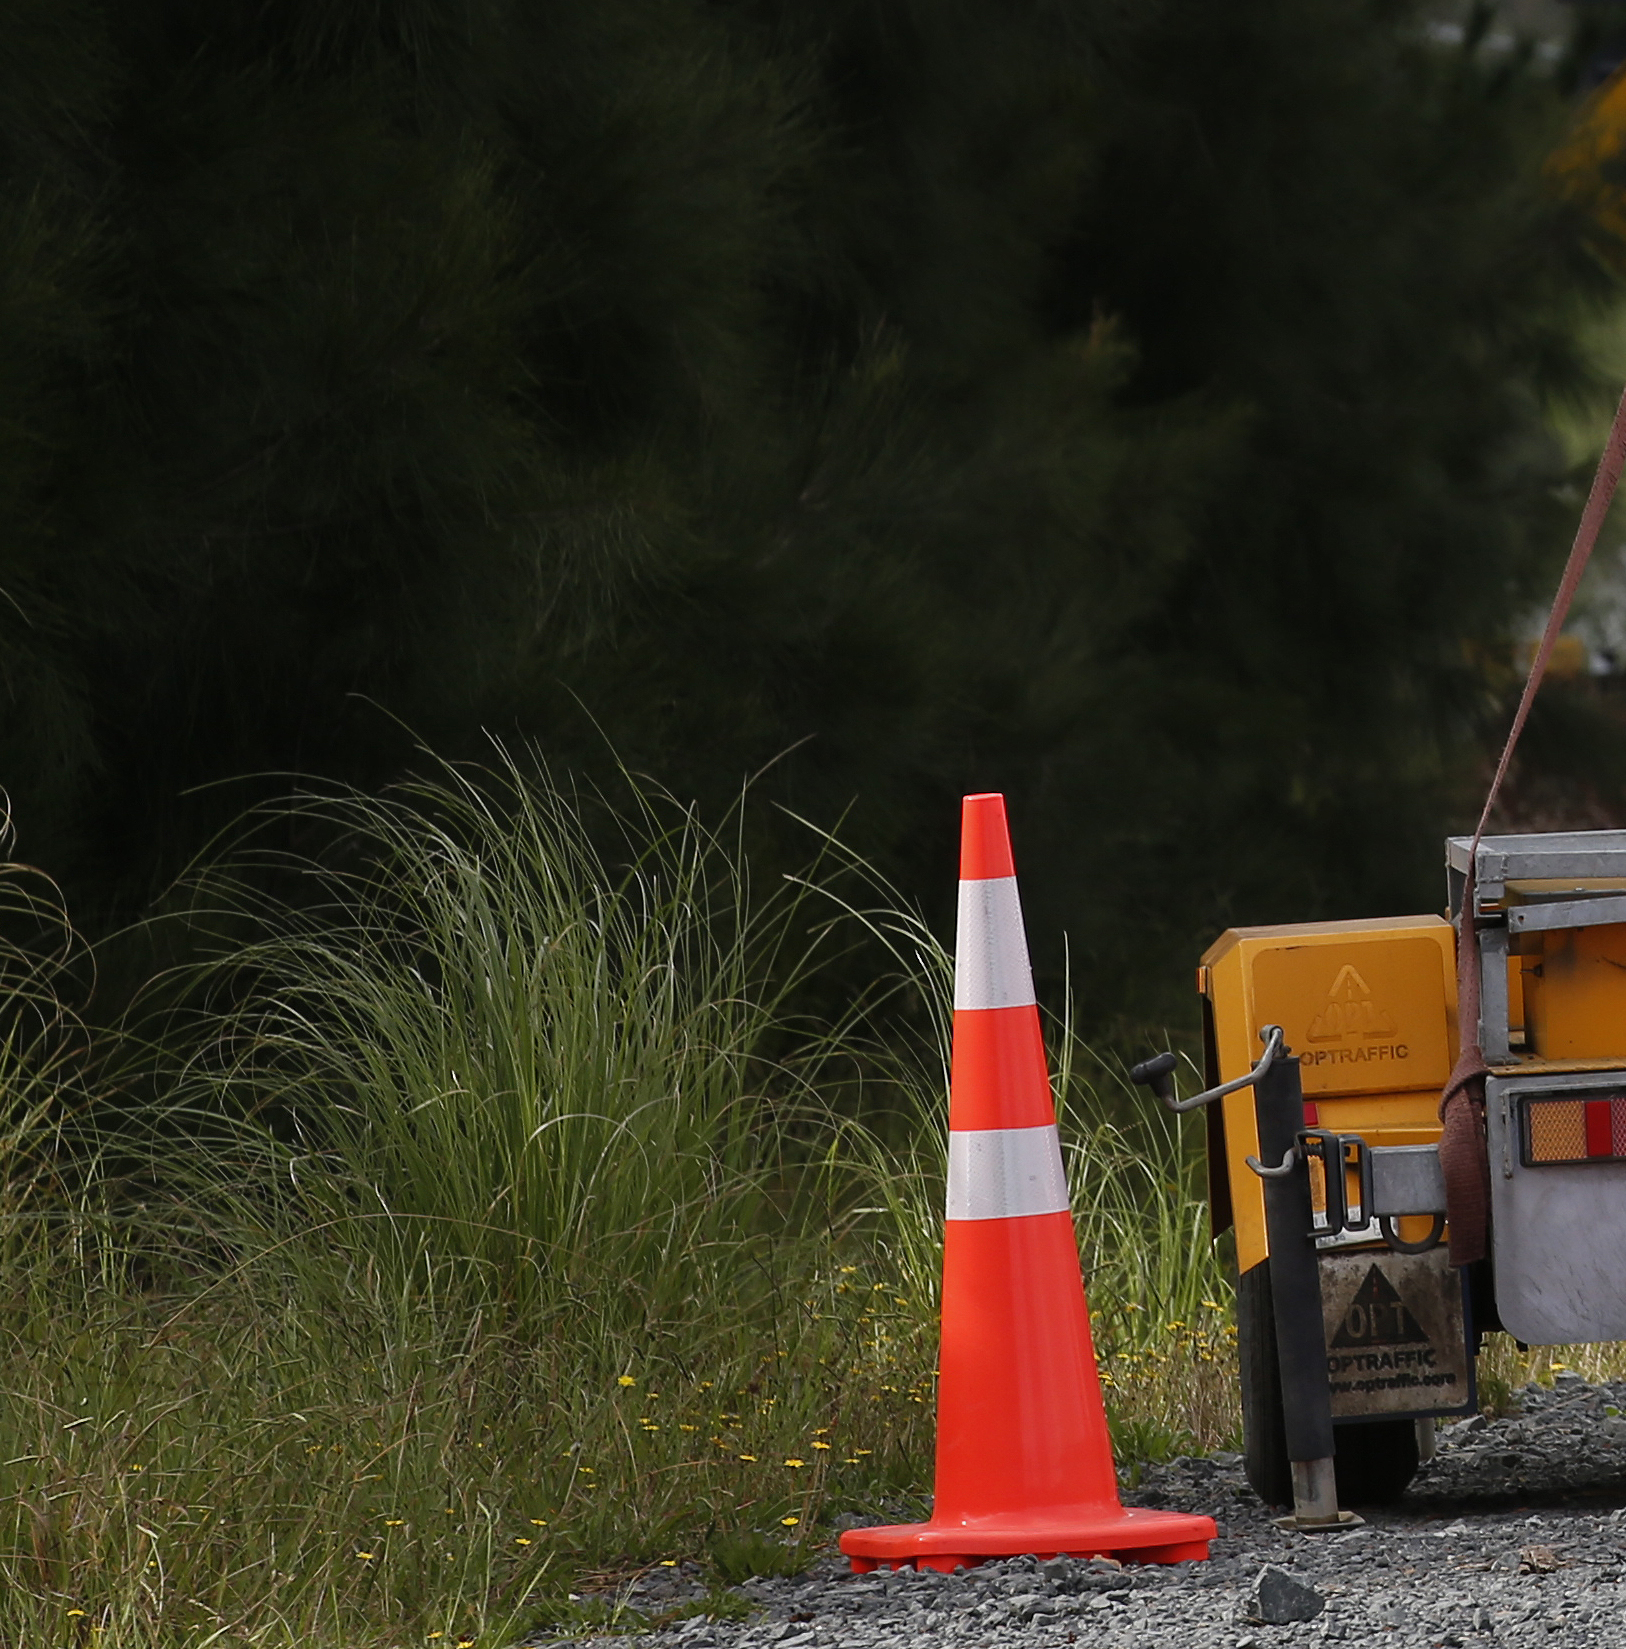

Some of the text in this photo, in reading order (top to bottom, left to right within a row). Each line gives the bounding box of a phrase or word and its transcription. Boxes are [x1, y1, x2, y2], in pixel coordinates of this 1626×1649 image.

[1300, 1044, 1409, 1067] OPTRAFFIC
[1345, 1301, 1407, 1339] OPT
[1327, 1349, 1437, 1373] OPTRAFFIC
